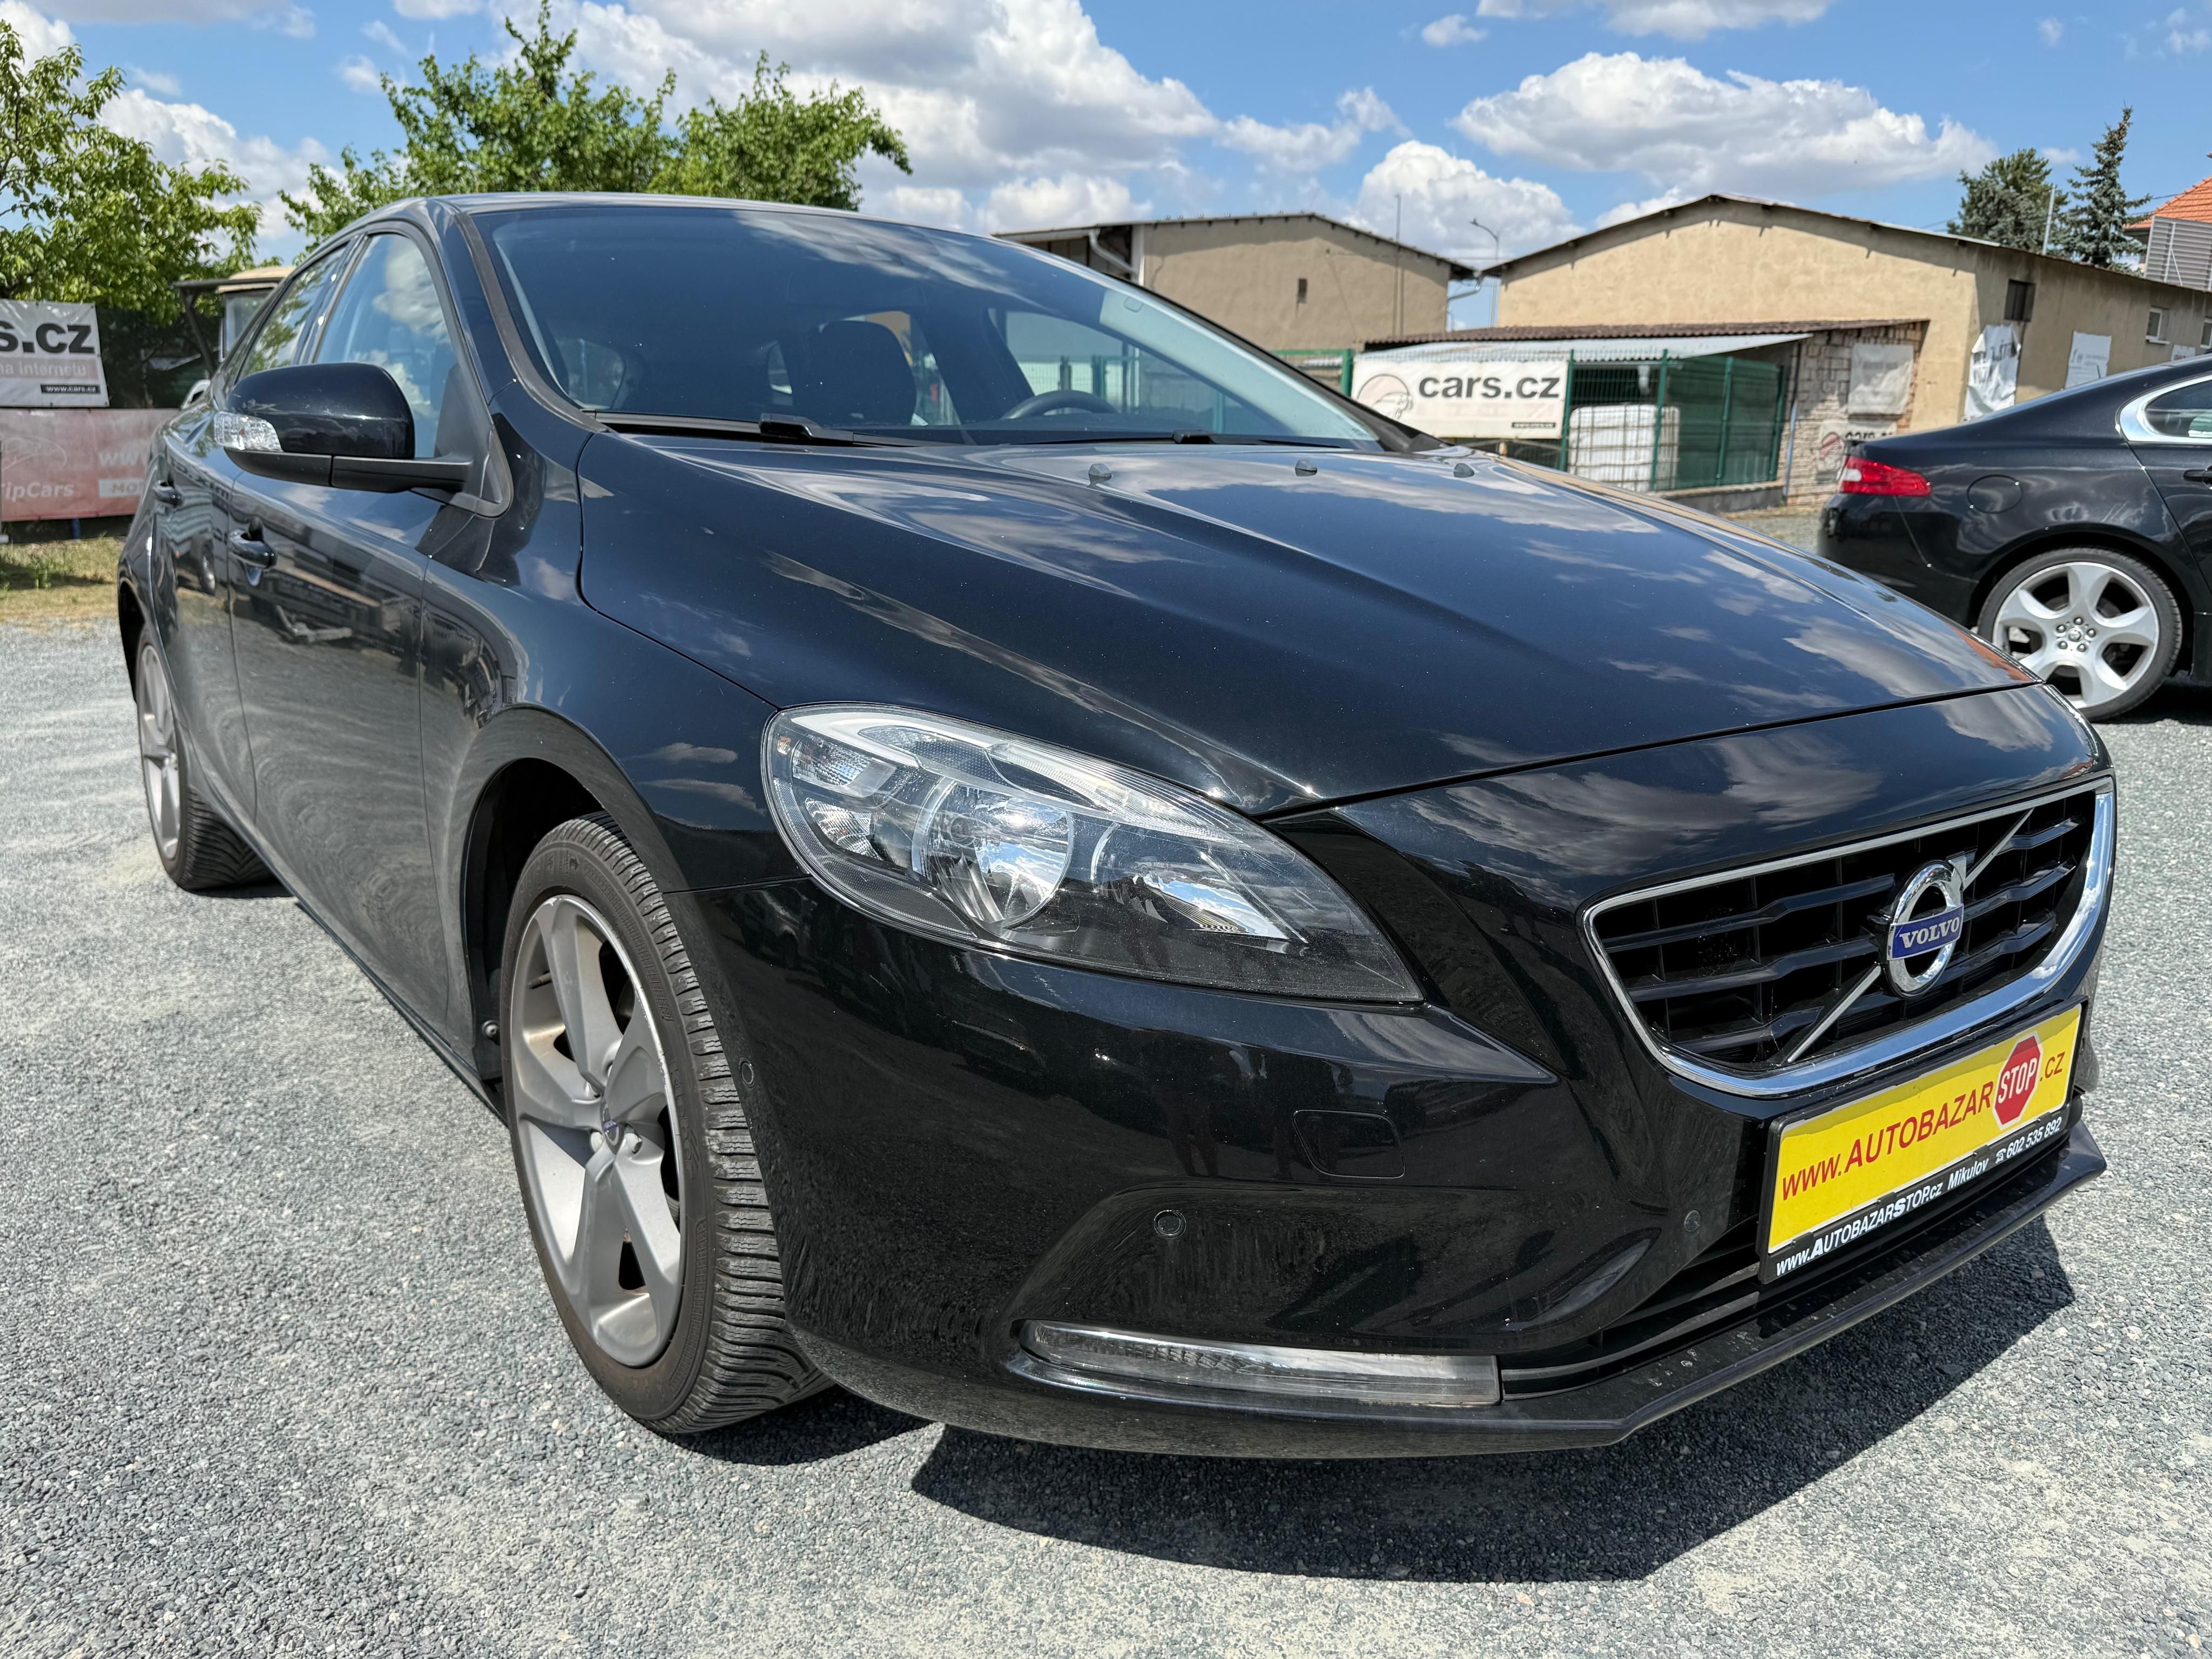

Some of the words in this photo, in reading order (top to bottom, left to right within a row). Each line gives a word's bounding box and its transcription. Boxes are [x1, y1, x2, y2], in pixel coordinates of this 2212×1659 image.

[1418, 377, 1560, 399] cars.cz
[2, 481, 75, 503] ipCars
[1899, 917, 1959, 948] VOLVO
[1998, 1057, 2037, 1104] STOP
[1777, 1182, 1943, 1276] www.AUTOBAZARSTOP.cz
[1947, 1158, 1989, 1190] Mikulov
[2006, 1136, 2025, 1159] 602
[2025, 1126, 2045, 1149] 535
[2044, 1116, 2062, 1138] 892
